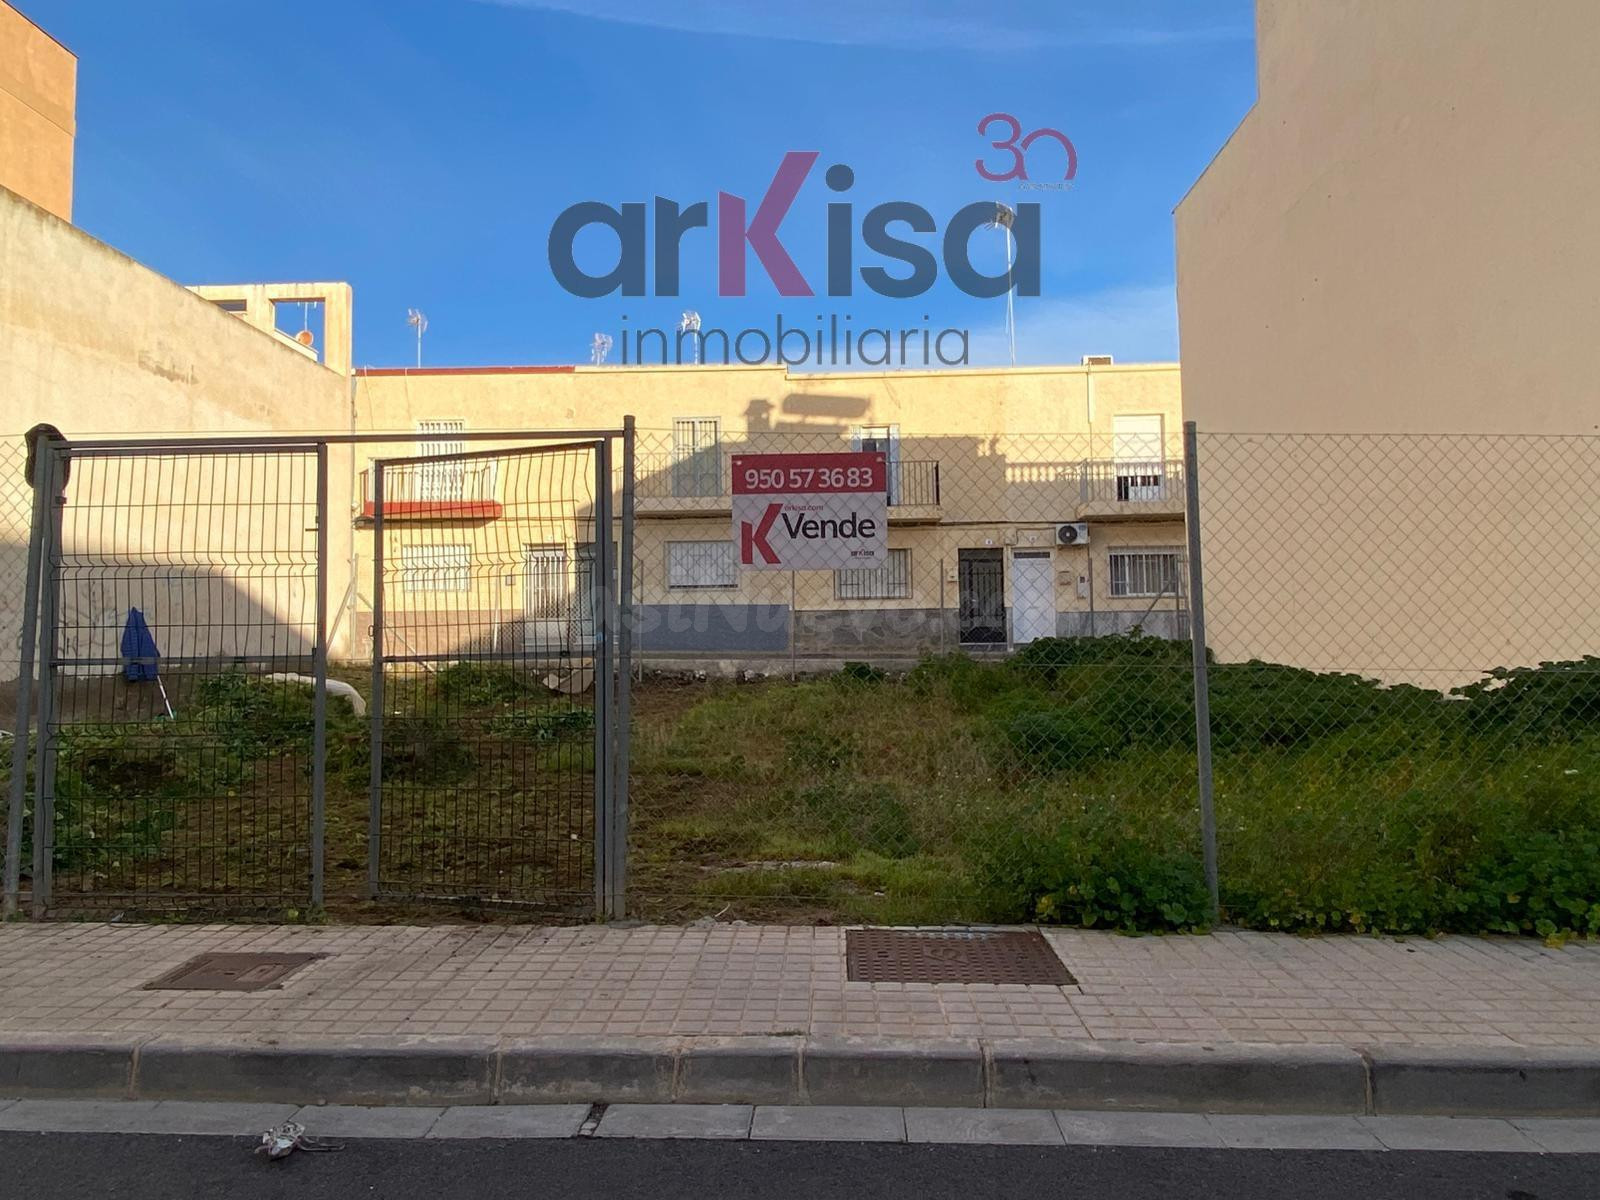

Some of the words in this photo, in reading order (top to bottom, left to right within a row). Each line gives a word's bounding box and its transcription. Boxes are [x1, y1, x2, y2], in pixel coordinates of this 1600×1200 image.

[745, 468, 785, 489] 950
[789, 467, 815, 488] 57
[818, 467, 845, 488] 36
[847, 466, 873, 487] 83
[781, 511, 876, 539] Vende
